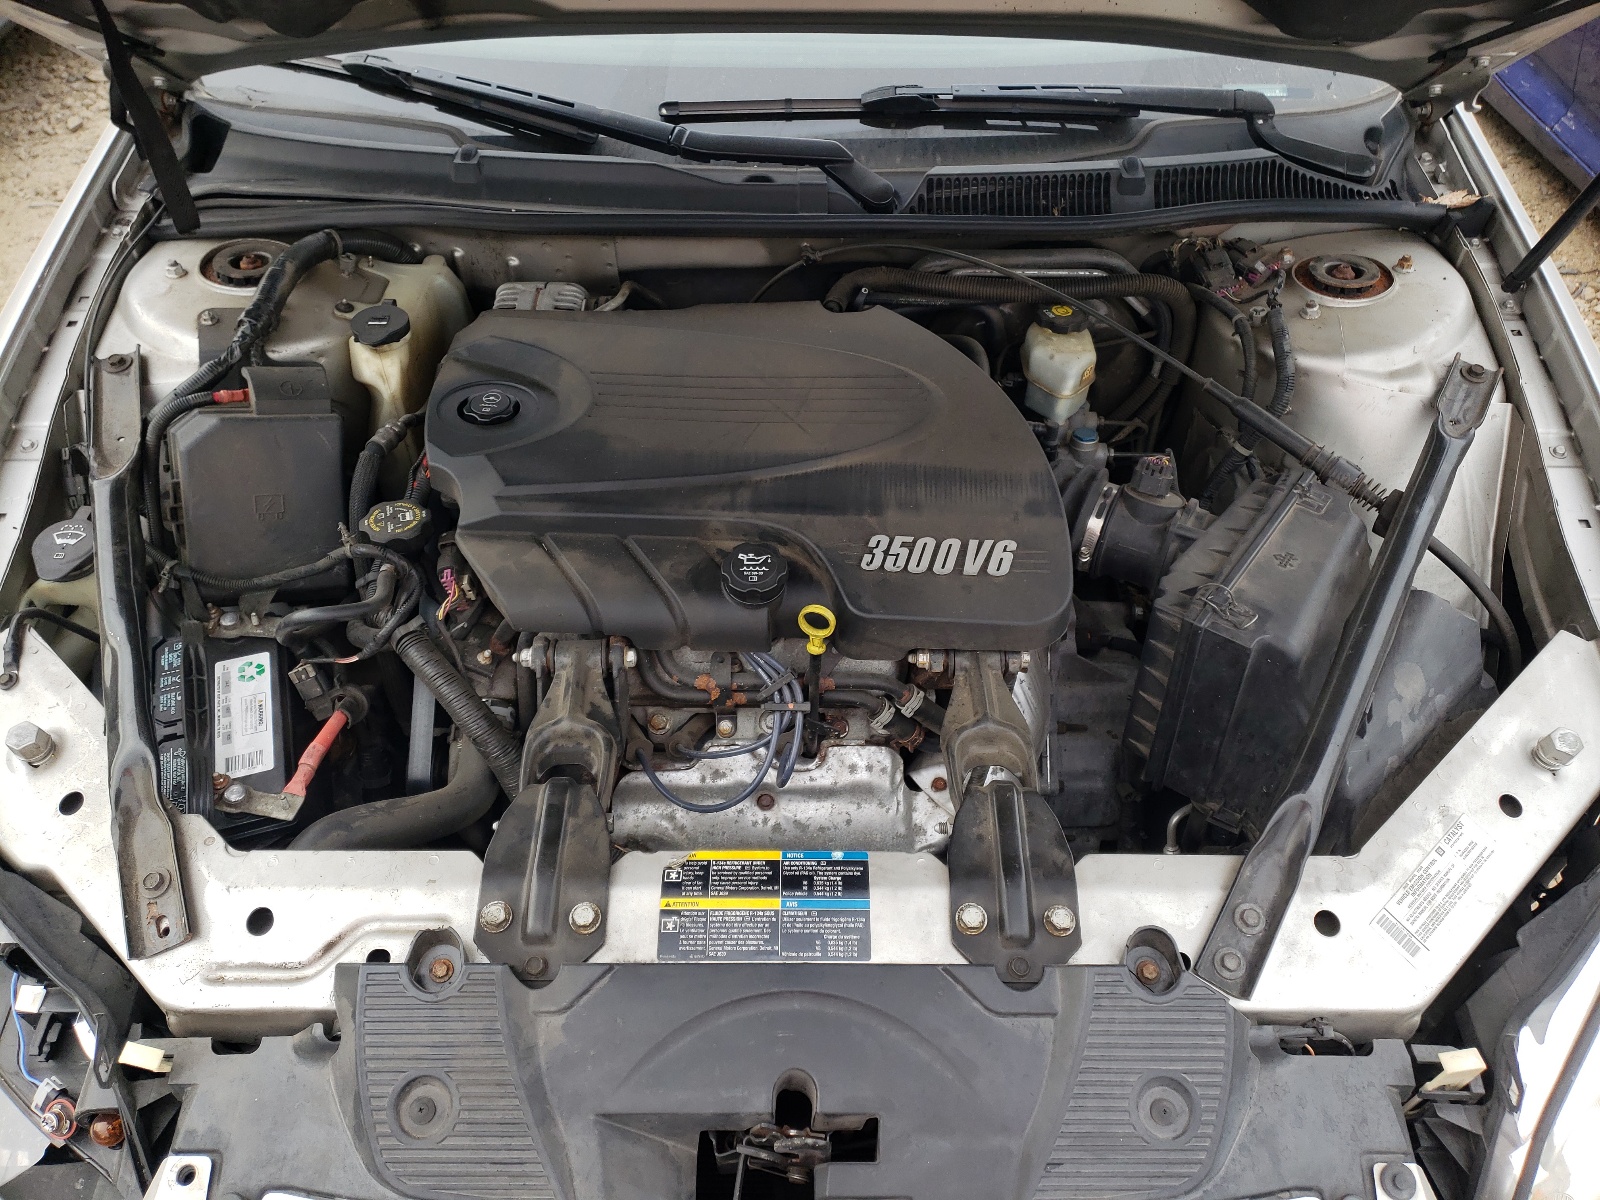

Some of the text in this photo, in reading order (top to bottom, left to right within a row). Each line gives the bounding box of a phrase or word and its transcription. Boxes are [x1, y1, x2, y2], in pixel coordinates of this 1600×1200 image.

[860, 534, 1017, 577] 3500 V6
[1443, 820, 1464, 845] CATALYST
[1395, 889, 1410, 905] VEHICLE
[1408, 873, 1424, 891] EMISSION
[1422, 857, 1437, 874] CONTROL
[1410, 872, 1432, 897] INFORMATION
